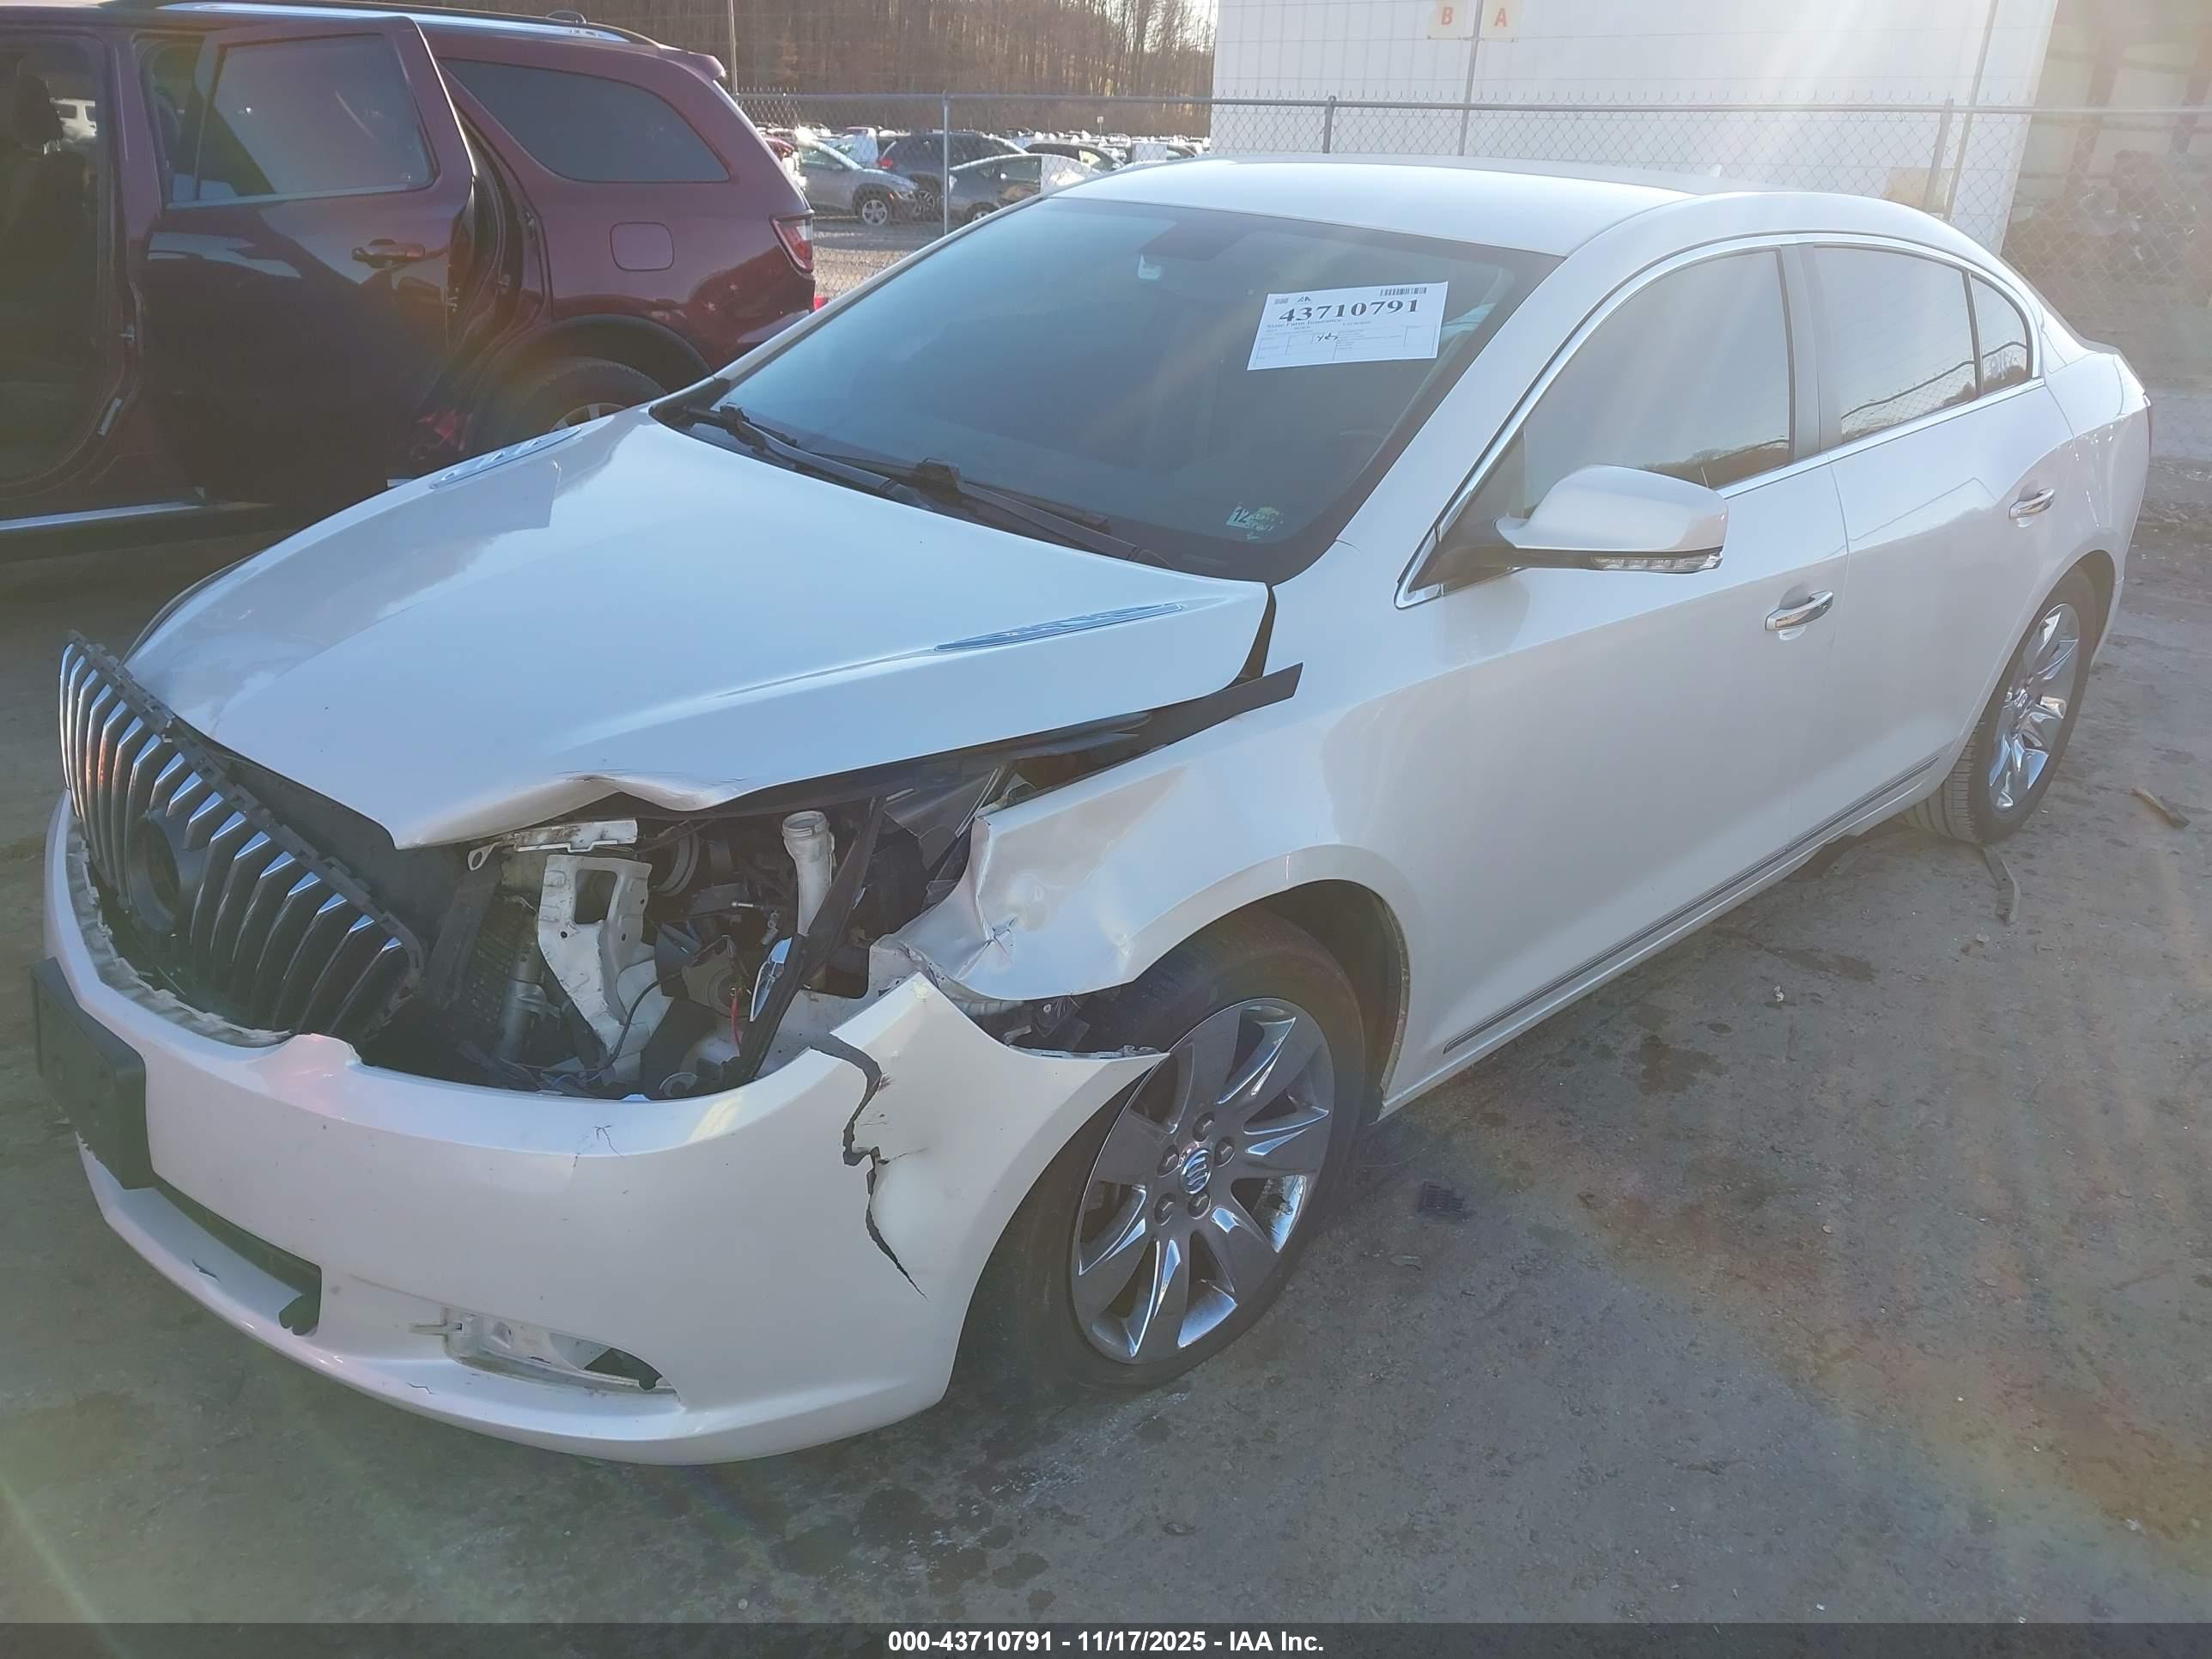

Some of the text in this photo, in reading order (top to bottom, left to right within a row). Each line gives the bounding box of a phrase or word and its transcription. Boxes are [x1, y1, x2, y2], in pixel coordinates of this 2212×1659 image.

[1441, 6, 1453, 26] B
[1494, 7, 1507, 27] A
[1279, 299, 1419, 323] 43710791
[1233, 507, 1251, 523] 12
